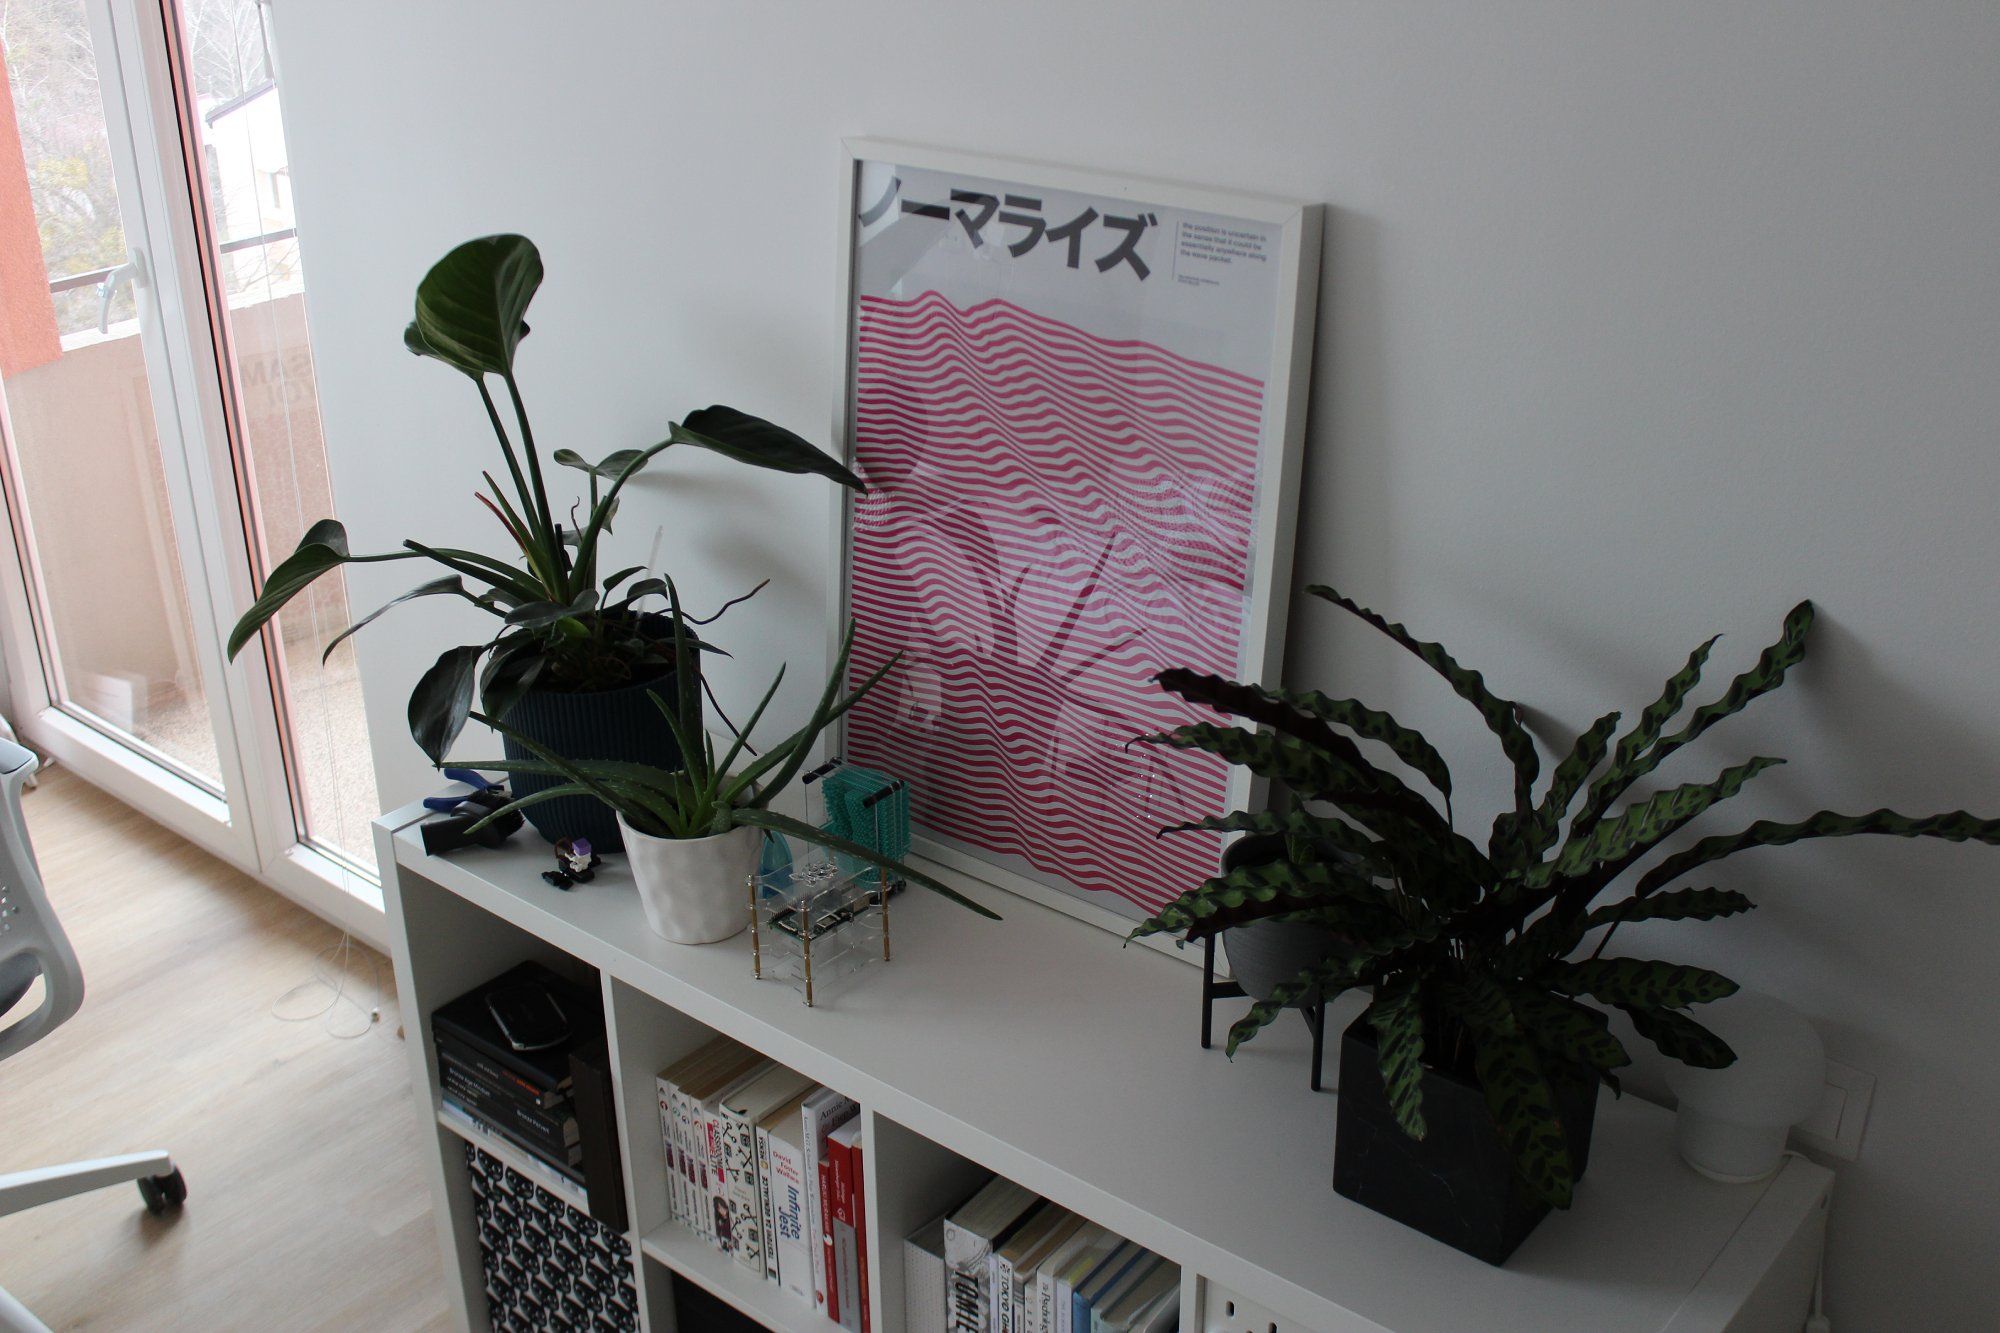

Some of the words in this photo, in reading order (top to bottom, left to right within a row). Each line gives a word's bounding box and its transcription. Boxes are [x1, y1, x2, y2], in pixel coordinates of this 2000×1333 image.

[859, 175, 1158, 282] ノーマライズ
[1194, 224, 1220, 234] position
[1228, 230, 1259, 240] uncertain
[1182, 231, 1192, 239] the
[1194, 233, 1213, 242] sense
[1214, 236, 1227, 244] that
[1233, 240, 1252, 248] could
[1253, 242, 1262, 250] be
[1181, 241, 1214, 253] essentially
[1216, 247, 1247, 257] anywhere
[1248, 253, 1267, 262] along
[1192, 251, 1208, 259] wave
[772, 1150, 792, 1165] David
[776, 1167, 800, 1185] Wallace
[780, 1161, 799, 1177] Foster
[778, 1206, 790, 1239] Jest
[788, 1185, 801, 1240] Infinite
[955, 1271, 979, 1333] TOMIE
[1001, 1275, 1010, 1312] TOKYO
